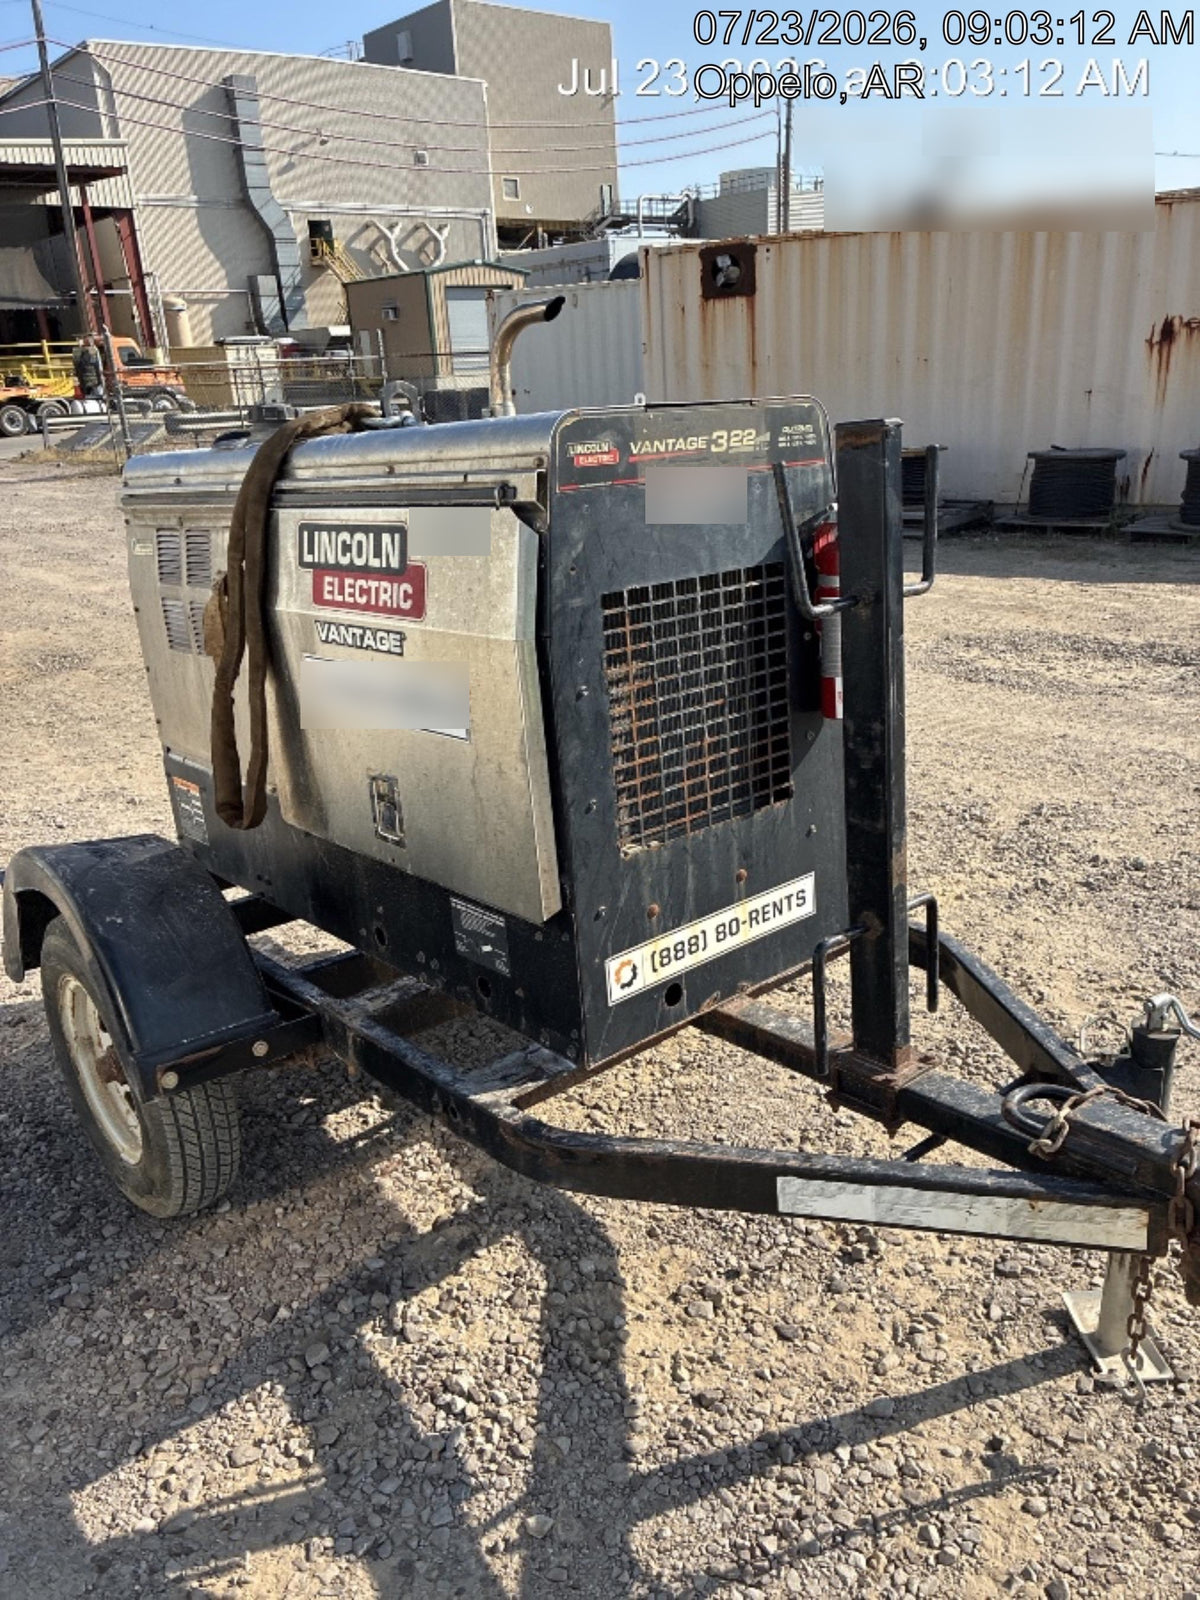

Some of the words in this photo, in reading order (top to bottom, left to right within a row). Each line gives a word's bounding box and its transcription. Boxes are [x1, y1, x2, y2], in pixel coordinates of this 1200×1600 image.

[629, 436, 709, 455] VANTAGE
[303, 530, 400, 569] LINCOLN
[322, 575, 413, 610] ELECTRIC
[315, 620, 405, 656] VANTAGE
[651, 929, 708, 973] (888)
[715, 888, 807, 943] 80-RENTS
